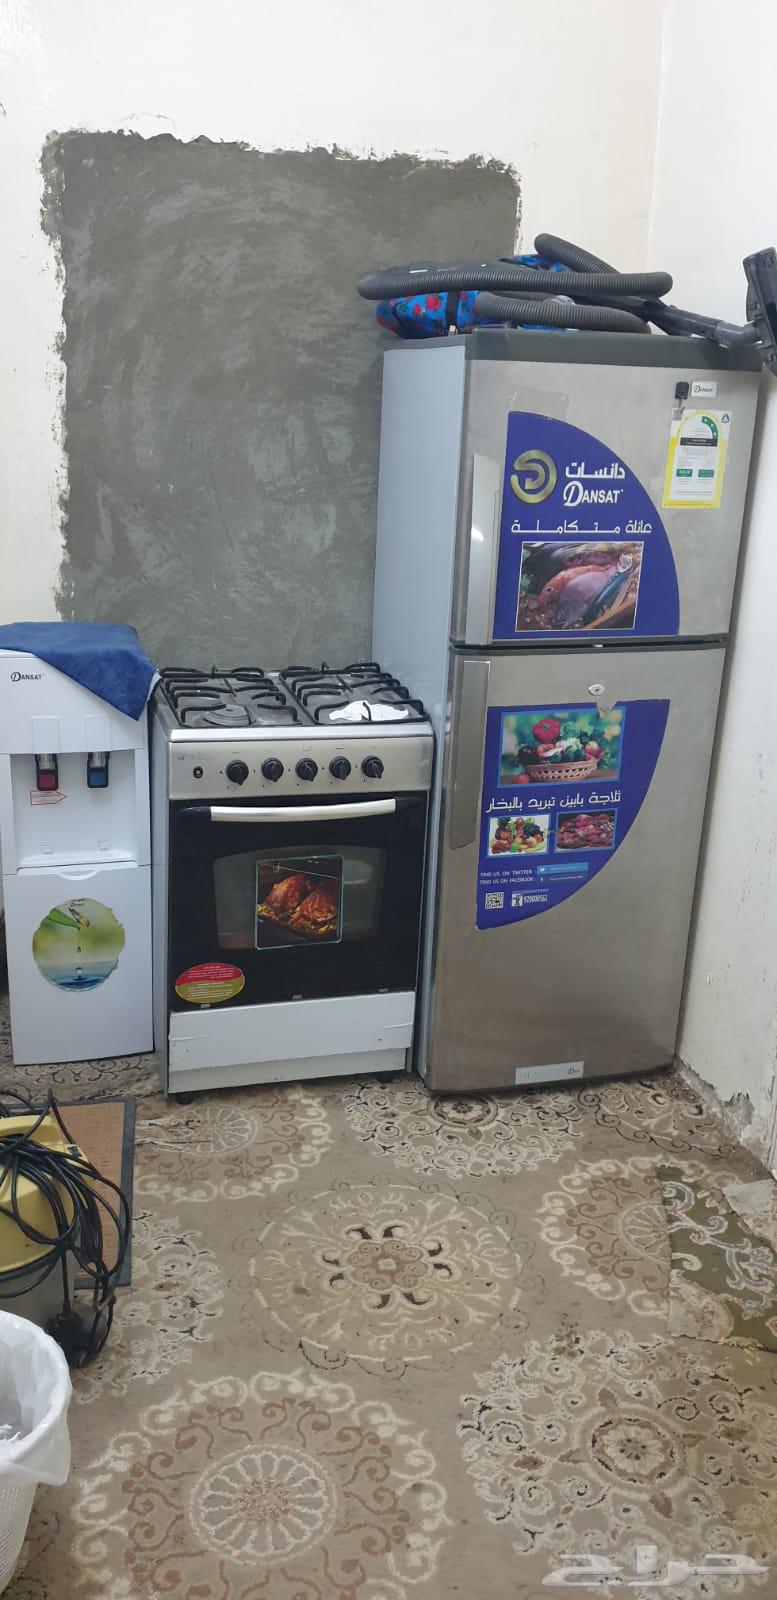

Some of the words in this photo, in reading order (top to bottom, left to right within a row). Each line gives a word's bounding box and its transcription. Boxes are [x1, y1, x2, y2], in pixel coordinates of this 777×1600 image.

[565, 462, 626, 479] دانسات
[563, 480, 620, 507] DANSAT
[511, 519, 621, 534] متكاملة
[10, 671, 41, 681] DANSAT
[485, 797, 523, 812] بالبخار
[528, 797, 555, 809] تبريد
[559, 793, 584, 808] بابين
[588, 790, 621, 805] ثلاجة
